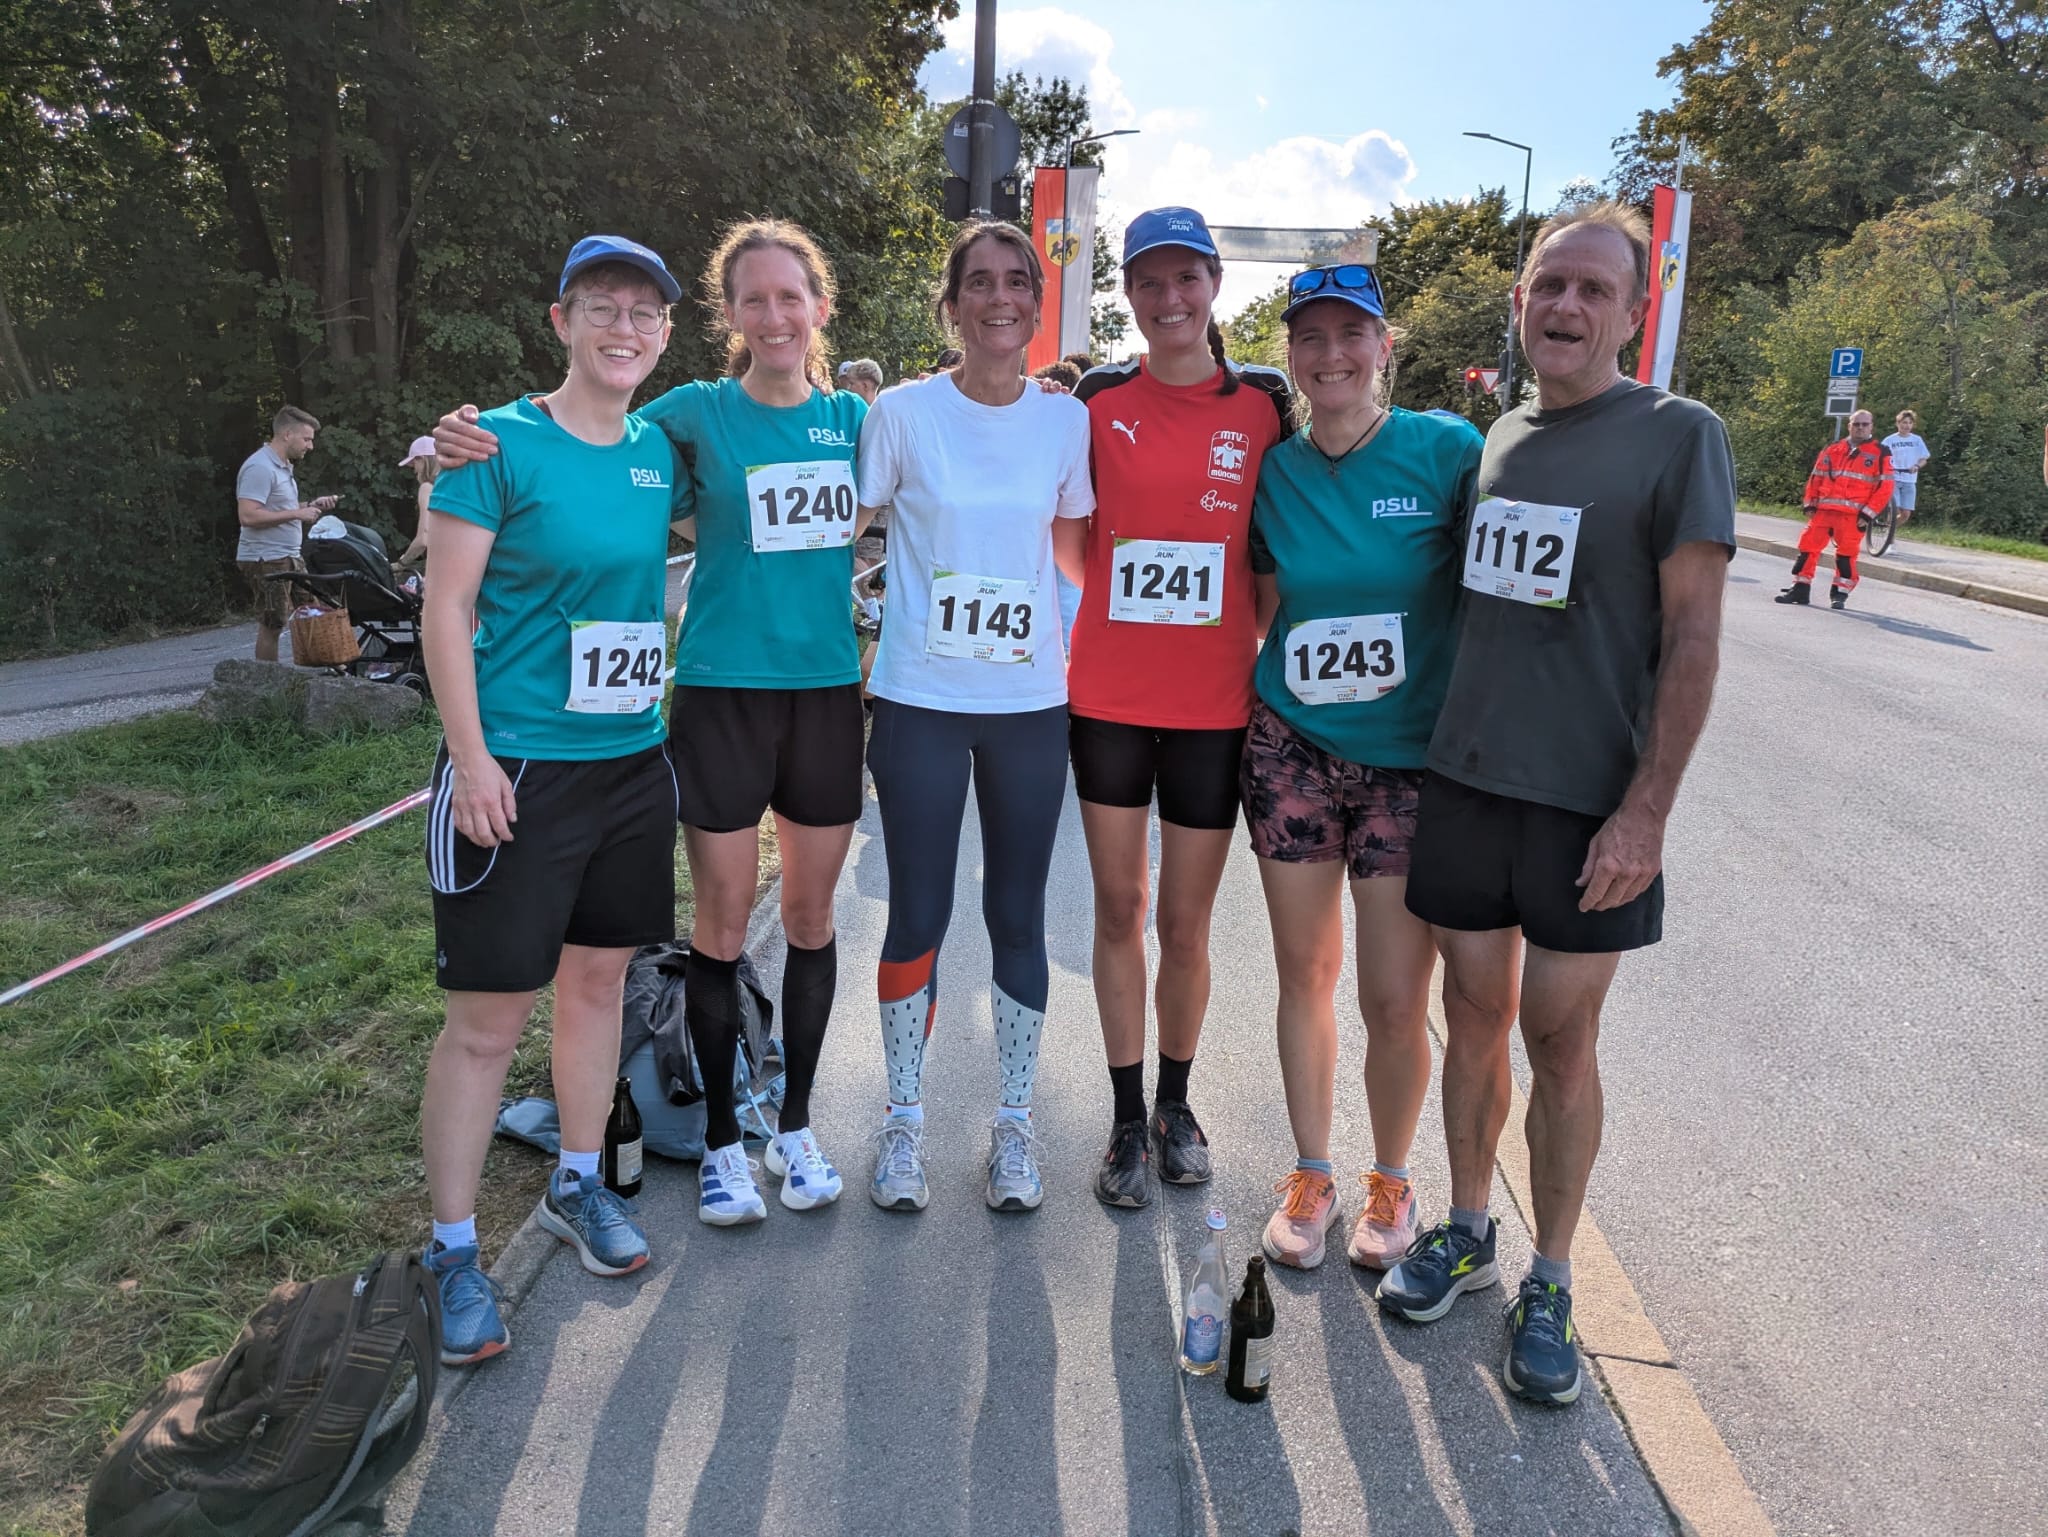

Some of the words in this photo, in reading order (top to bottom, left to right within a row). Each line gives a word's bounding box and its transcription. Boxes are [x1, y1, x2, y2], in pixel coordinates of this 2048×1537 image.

[1837, 352, 1855, 373] P
[808, 428, 846, 444] psu
[630, 467, 661, 487] psu
[758, 484, 853, 526] 1240
[1215, 500, 1238, 511] HYVE
[1372, 496, 1417, 519] psu
[1474, 521, 1564, 578] 1112
[1120, 562, 1210, 601] 1241
[938, 596, 1032, 640] 1143
[582, 647, 662, 688] 1242
[1294, 638, 1395, 680] 1243
